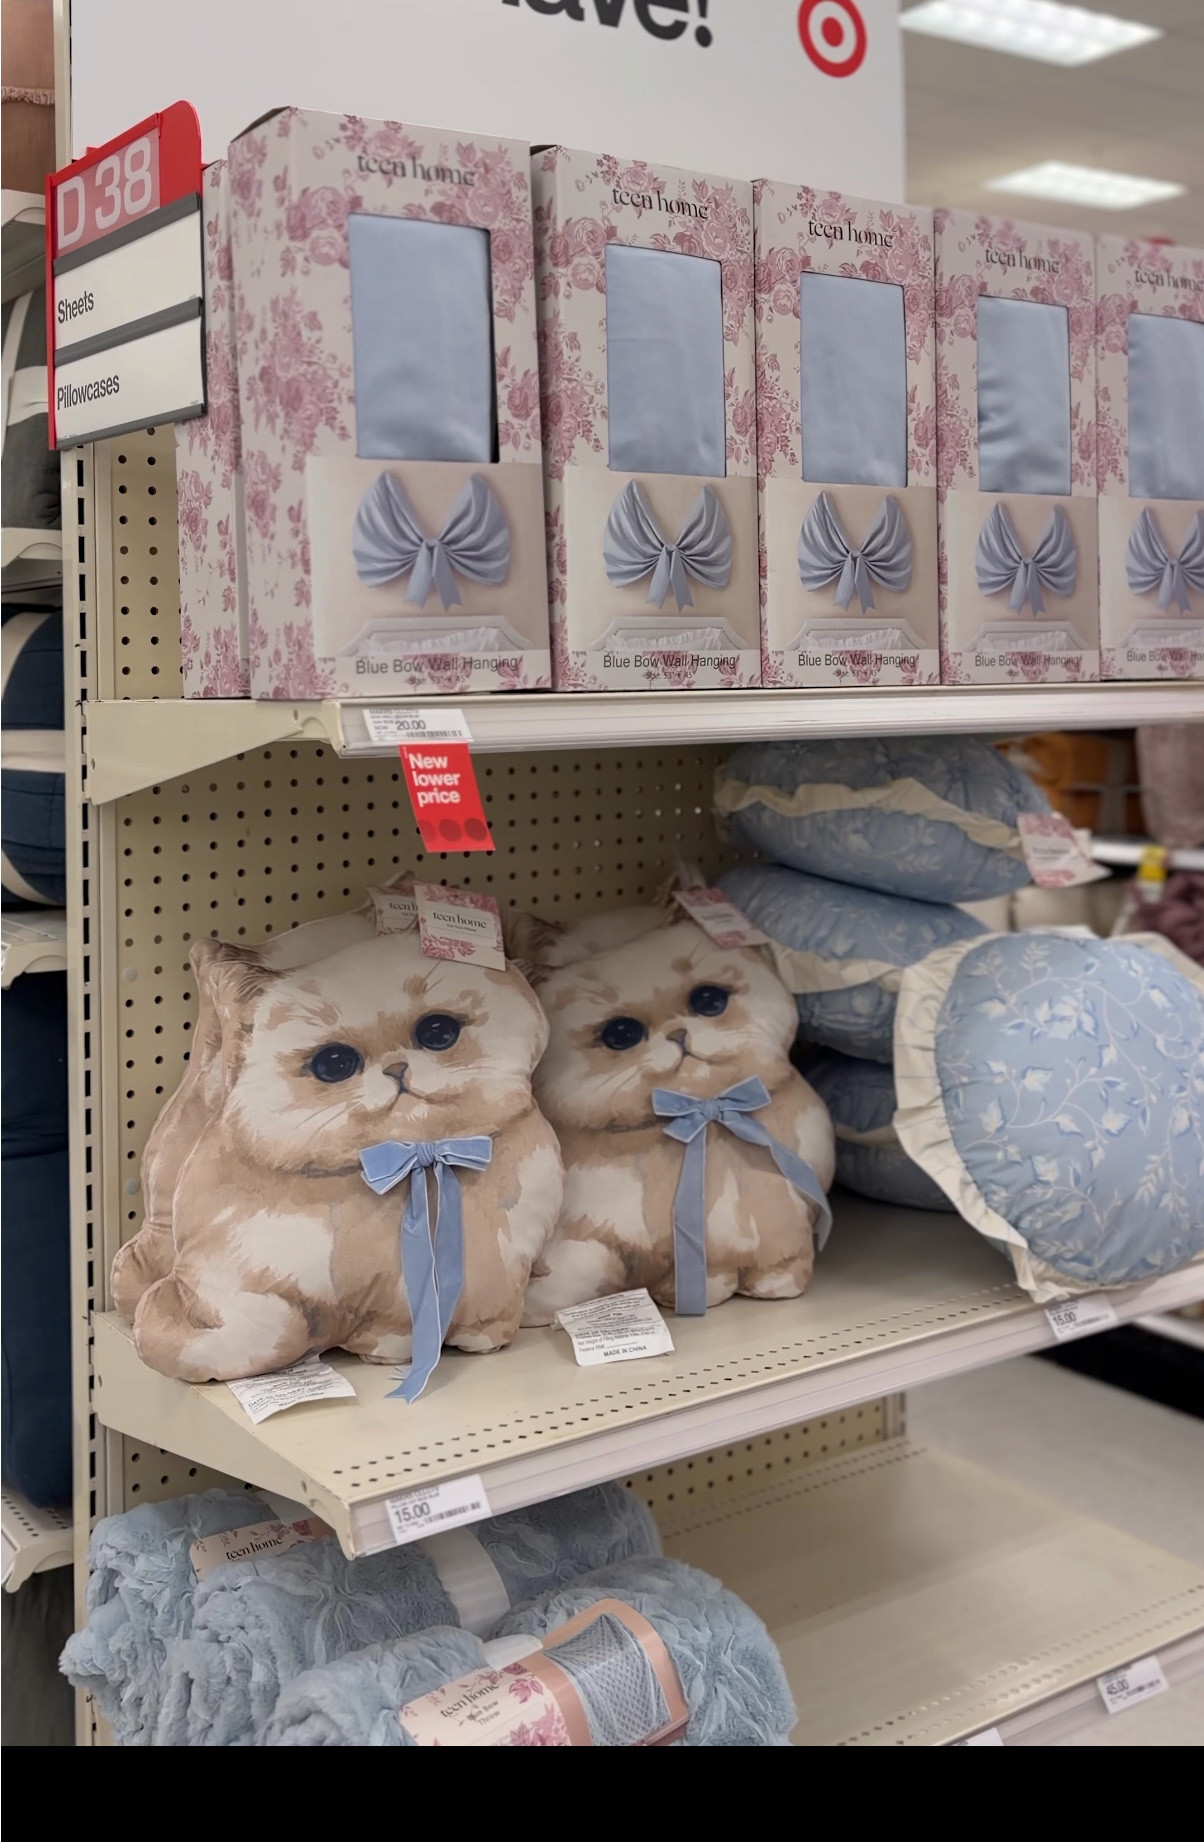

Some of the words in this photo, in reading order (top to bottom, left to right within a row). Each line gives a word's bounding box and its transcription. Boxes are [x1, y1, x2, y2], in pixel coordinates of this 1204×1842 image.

[357, 155, 406, 178] teen
[411, 155, 476, 188] home
[57, 175, 86, 250] D
[94, 136, 152, 230] 38
[612, 188, 653, 210] teen
[656, 189, 709, 219] home
[808, 220, 844, 240] teen
[848, 220, 894, 248] home
[985, 248, 1016, 267] teen
[1019, 248, 1060, 274] home
[57, 291, 94, 324] Sheets
[57, 373, 120, 411] Pillowcases
[603, 655, 631, 668] Blue
[634, 655, 660, 668] Bow
[663, 654, 688, 667] Wall
[691, 653, 737, 670] Hanging
[798, 653, 822, 667] Blue
[825, 653, 848, 667] Bow
[850, 653, 872, 666] Wall
[875, 652, 916, 668] Hanging
[975, 655, 996, 667] Blue
[998, 655, 1019, 667] Bow
[1020, 654, 1040, 666] Wall
[1043, 654, 1080, 668] Hanging
[1126, 650, 1147, 662] Blue
[356, 659, 388, 675] Blue
[393, 658, 423, 673] Bow
[427, 656, 458, 671] Wall
[463, 656, 518, 673] Hanging
[396, 719, 427, 731] 20.00
[408, 753, 448, 769] New
[412, 770, 460, 787] lower
[416, 787, 461, 808] price
[433, 911, 455, 923] teen
[457, 914, 487, 928] home
[1053, 1311, 1077, 1326] 15.00
[603, 1349, 621, 1357] MADE
[629, 1345, 647, 1353] CHINA
[394, 1501, 431, 1524] 15.00
[226, 1547, 251, 1560] teen
[250, 1536, 283, 1552] home
[1106, 1678, 1130, 1695] 45.00
[440, 1699, 467, 1717] teen
[462, 1683, 500, 1704] home
[482, 1700, 499, 1712] Bow
[478, 1710, 500, 1726] Throw
